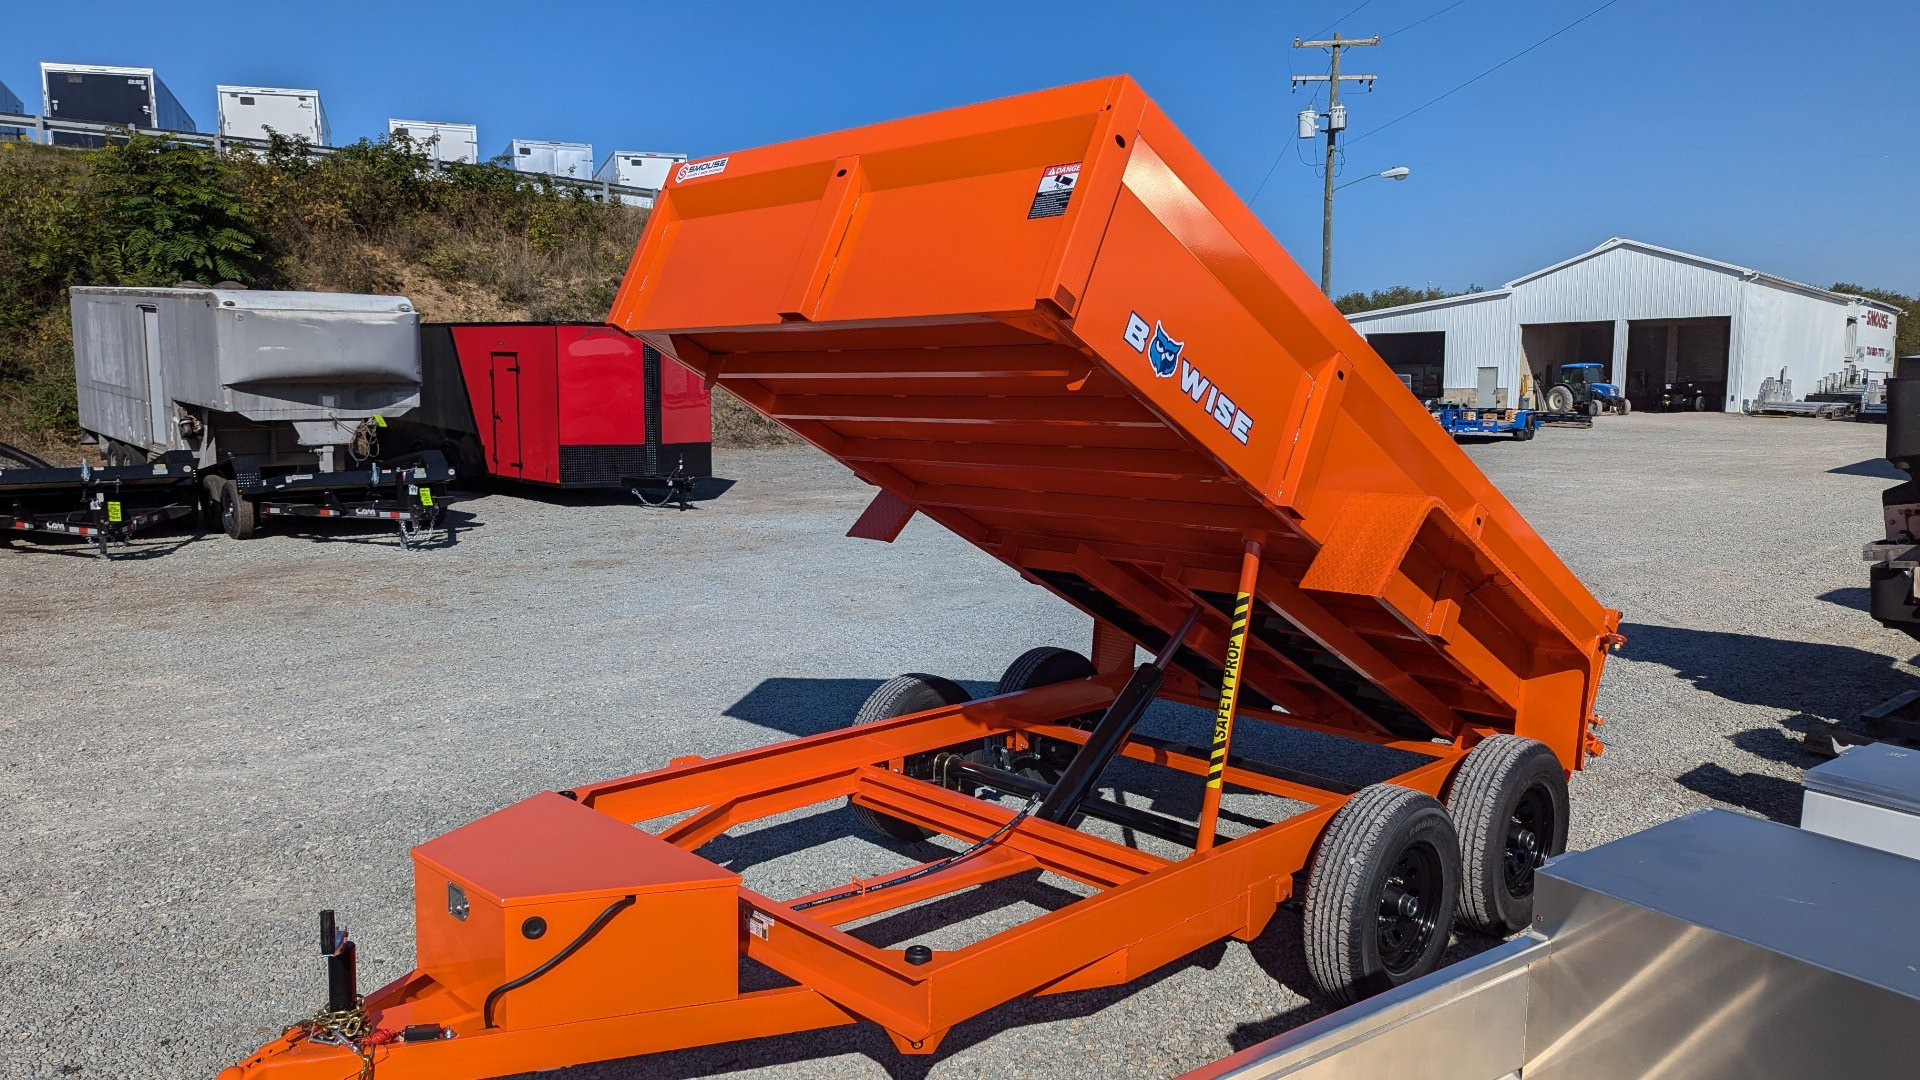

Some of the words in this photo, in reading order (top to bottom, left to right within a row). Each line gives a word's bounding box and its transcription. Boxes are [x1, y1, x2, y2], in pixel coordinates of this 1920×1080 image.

[688, 159, 727, 173] SMOUSE
[1056, 164, 1082, 175] DANGE
[1214, 683, 1234, 740] SAFETY
[1224, 639, 1242, 680] PROP
